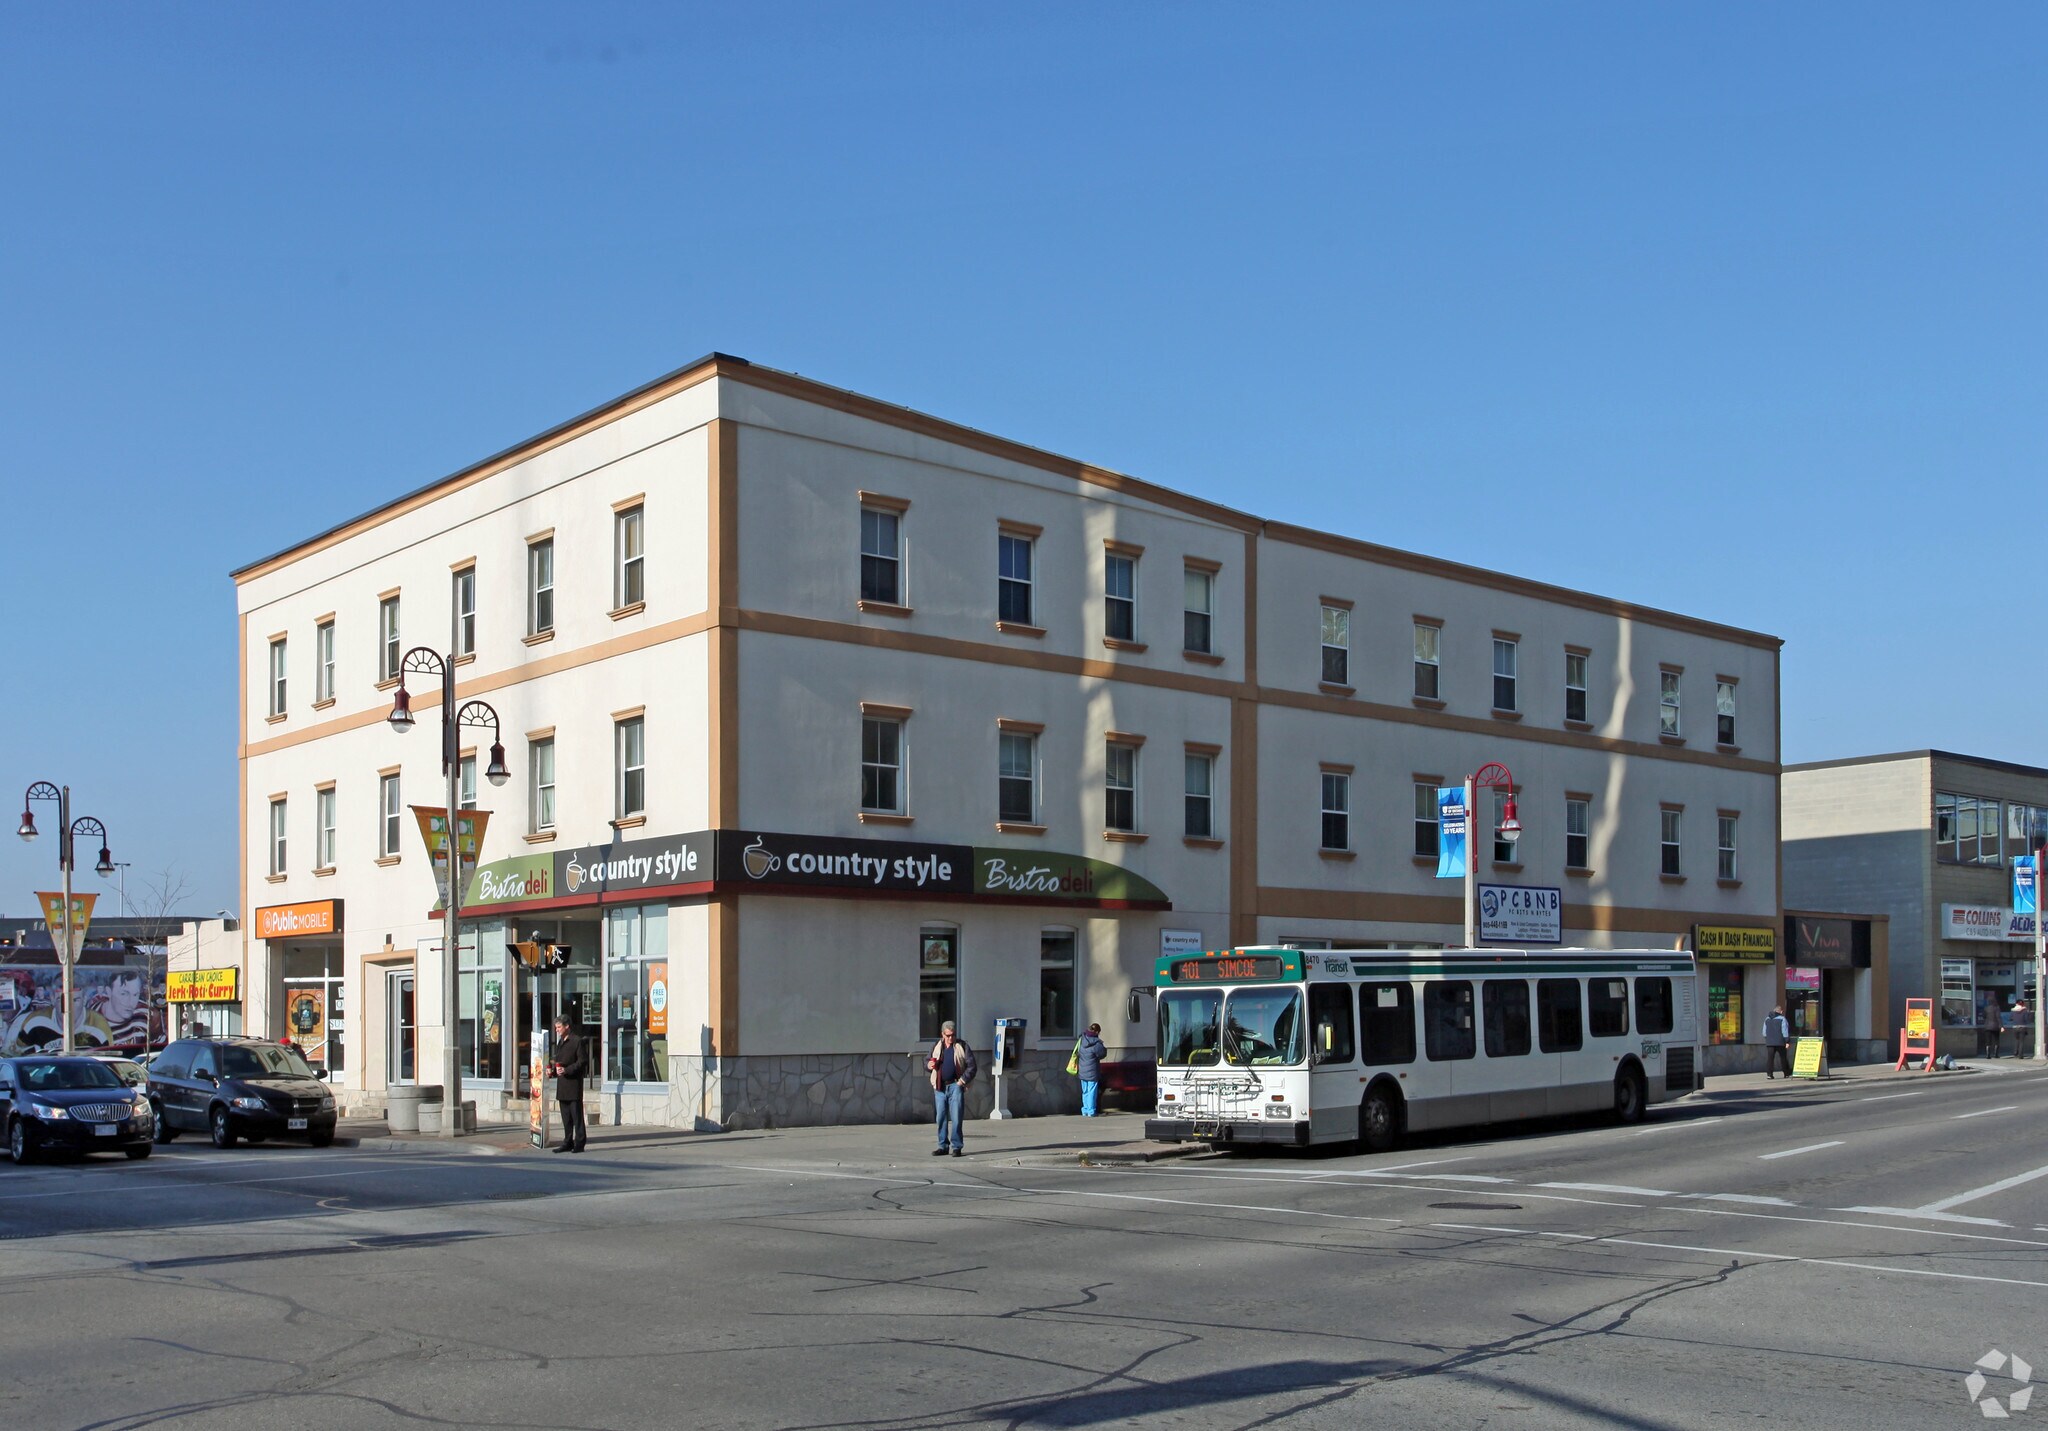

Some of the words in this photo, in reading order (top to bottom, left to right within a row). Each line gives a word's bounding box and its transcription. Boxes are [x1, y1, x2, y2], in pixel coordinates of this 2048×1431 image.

[590, 854, 652, 884] country
[655, 844, 698, 880] style
[787, 853, 888, 884] country
[894, 854, 952, 886] style
[1966, 910, 2001, 926] COLLINS
[2010, 916, 2048, 932] ACDeco
[1718, 932, 1723, 946] N
[1742, 932, 1772, 947] FINANCIAL
[1305, 956, 1320, 964] 8470
[1324, 960, 1348, 973] Transit
[1182, 962, 1200, 979] 401
[1218, 958, 1256, 978] SIMCOE
[179, 972, 204, 984] CARRIEAN
